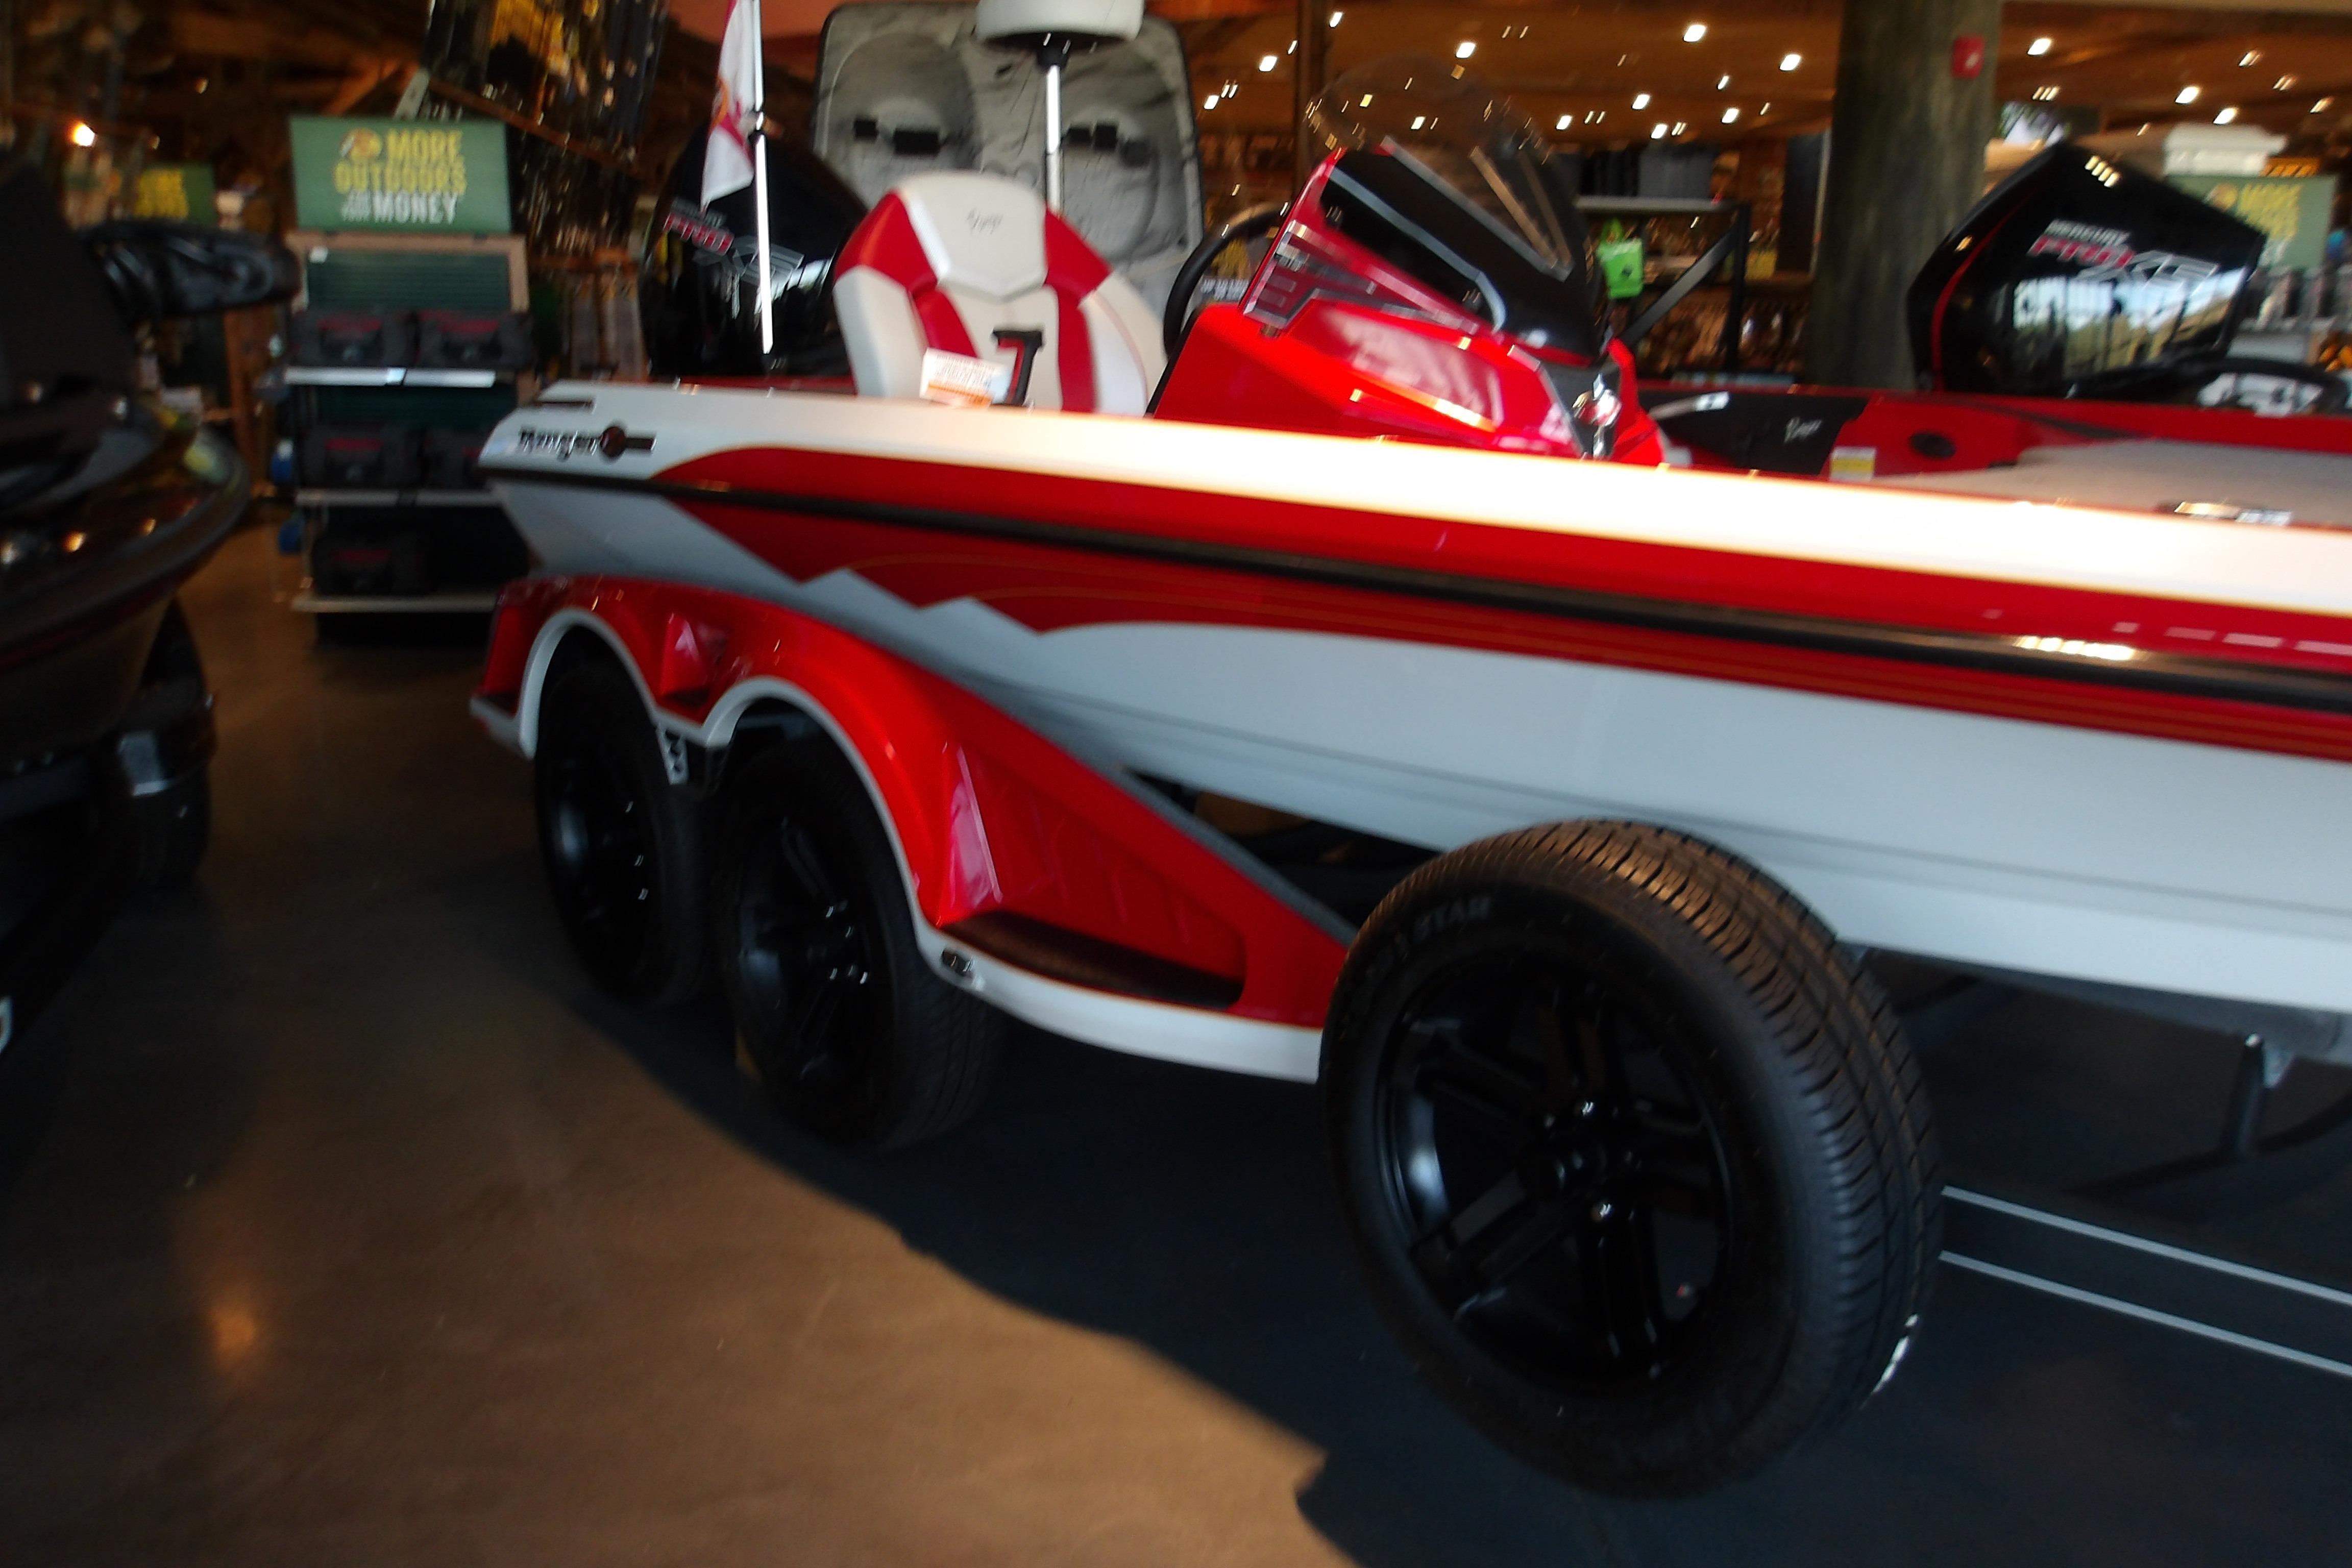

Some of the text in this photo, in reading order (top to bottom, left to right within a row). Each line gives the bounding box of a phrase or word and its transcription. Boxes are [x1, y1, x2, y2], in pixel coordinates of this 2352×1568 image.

[386, 128, 463, 162] MORE
[333, 156, 467, 195] OUTDOORS
[373, 189, 459, 224] MONEY
